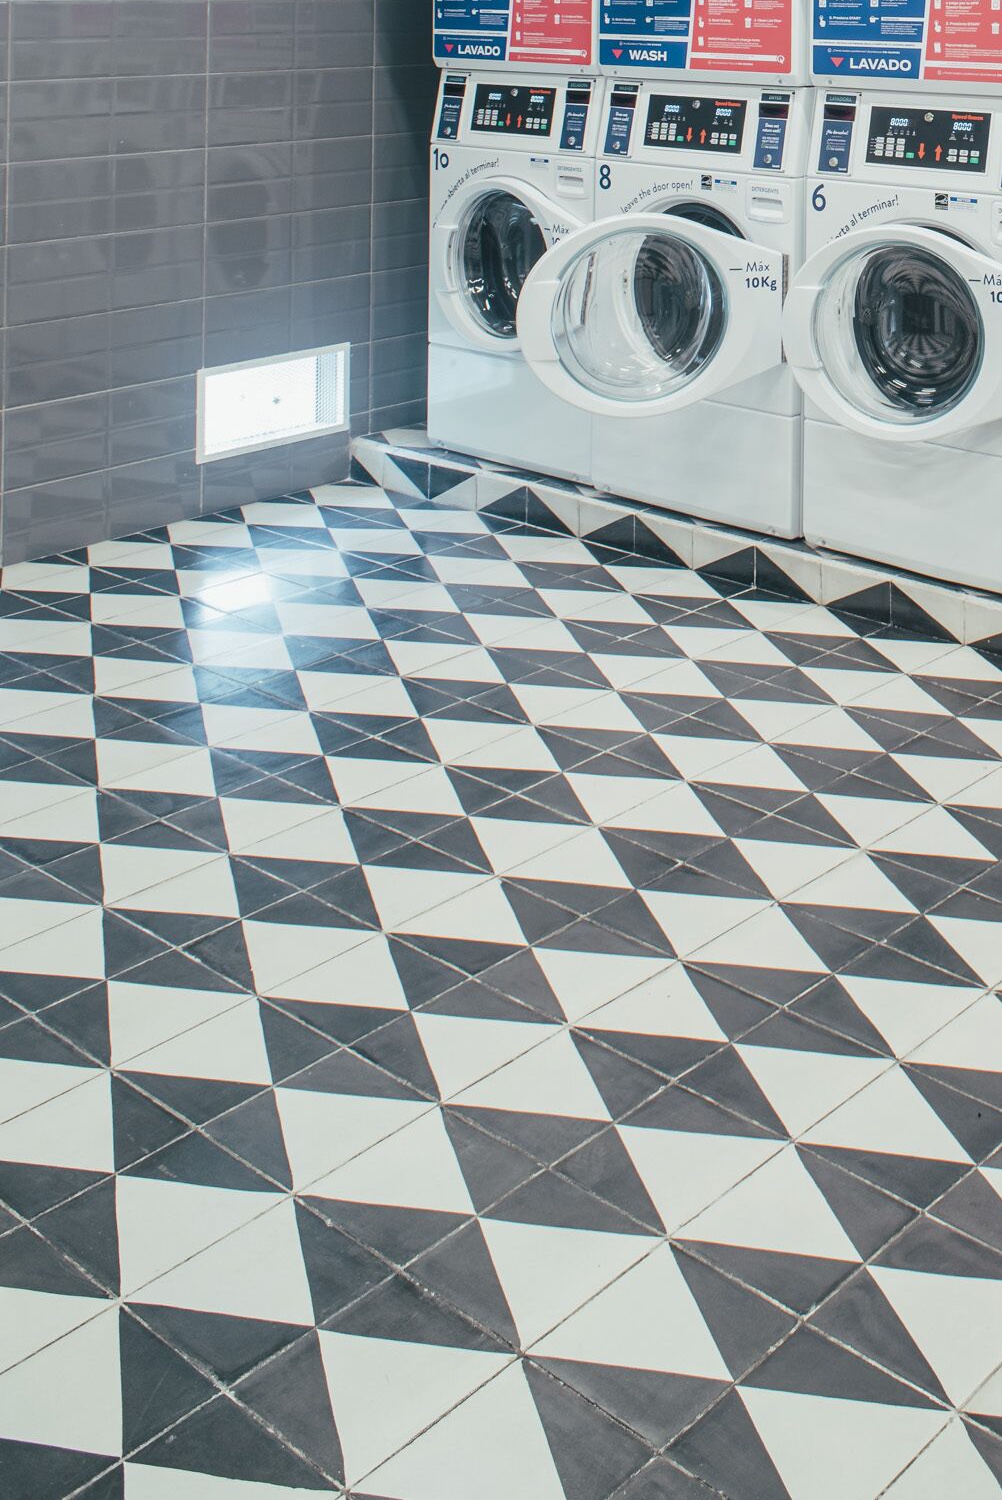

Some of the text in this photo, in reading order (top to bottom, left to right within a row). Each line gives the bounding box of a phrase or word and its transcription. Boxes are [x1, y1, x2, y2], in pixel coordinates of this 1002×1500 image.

[458, 44, 501, 56] LAVADO
[629, 49, 668, 62] WASH
[849, 57, 912, 72] LAVADO
[433, 148, 450, 170] 10
[600, 164, 611, 190] 8
[620, 179, 694, 214] leave the door open!
[812, 183, 827, 212] 6
[850, 214, 859, 227] al
[858, 194, 899, 220] terminar!
[552, 223, 570, 234] Máx
[745, 260, 770, 272] Máx
[745, 276, 777, 292] 10Kg
